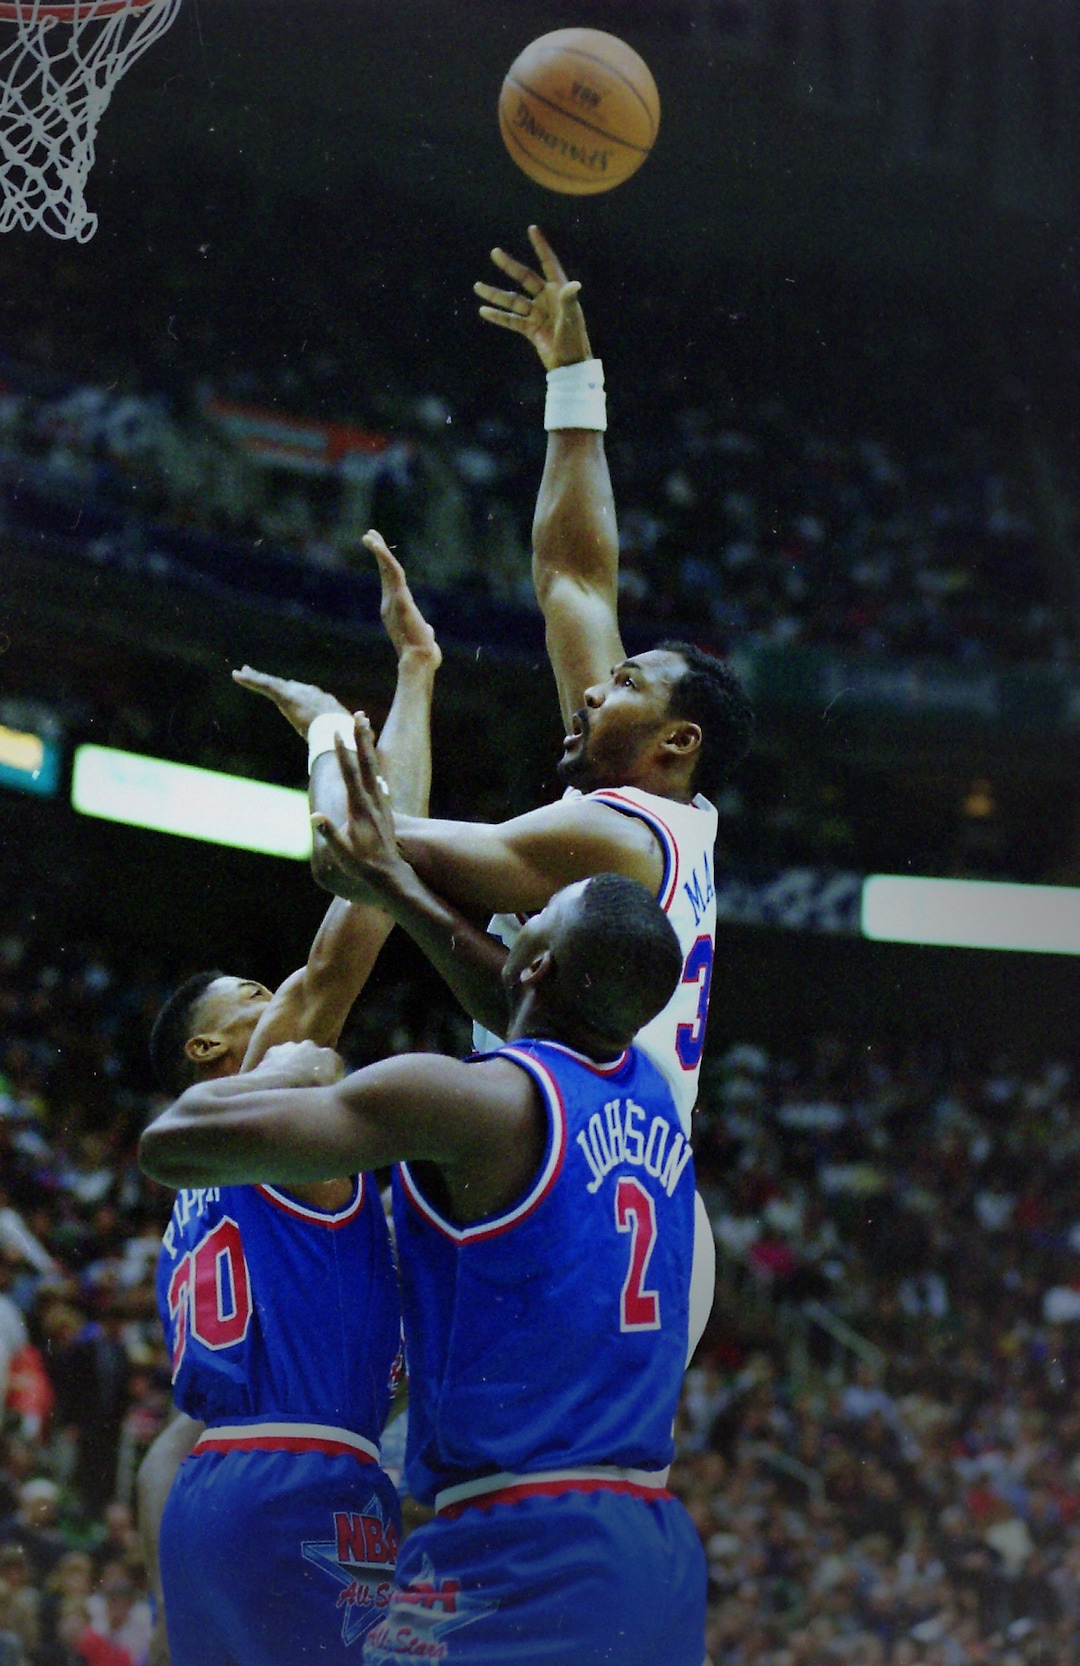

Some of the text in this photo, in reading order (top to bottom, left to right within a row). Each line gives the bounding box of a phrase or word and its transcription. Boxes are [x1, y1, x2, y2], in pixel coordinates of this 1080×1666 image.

[675, 934, 715, 1071] 3
[576, 1098, 693, 1198] JOHSON
[614, 1176, 661, 1333] 2
